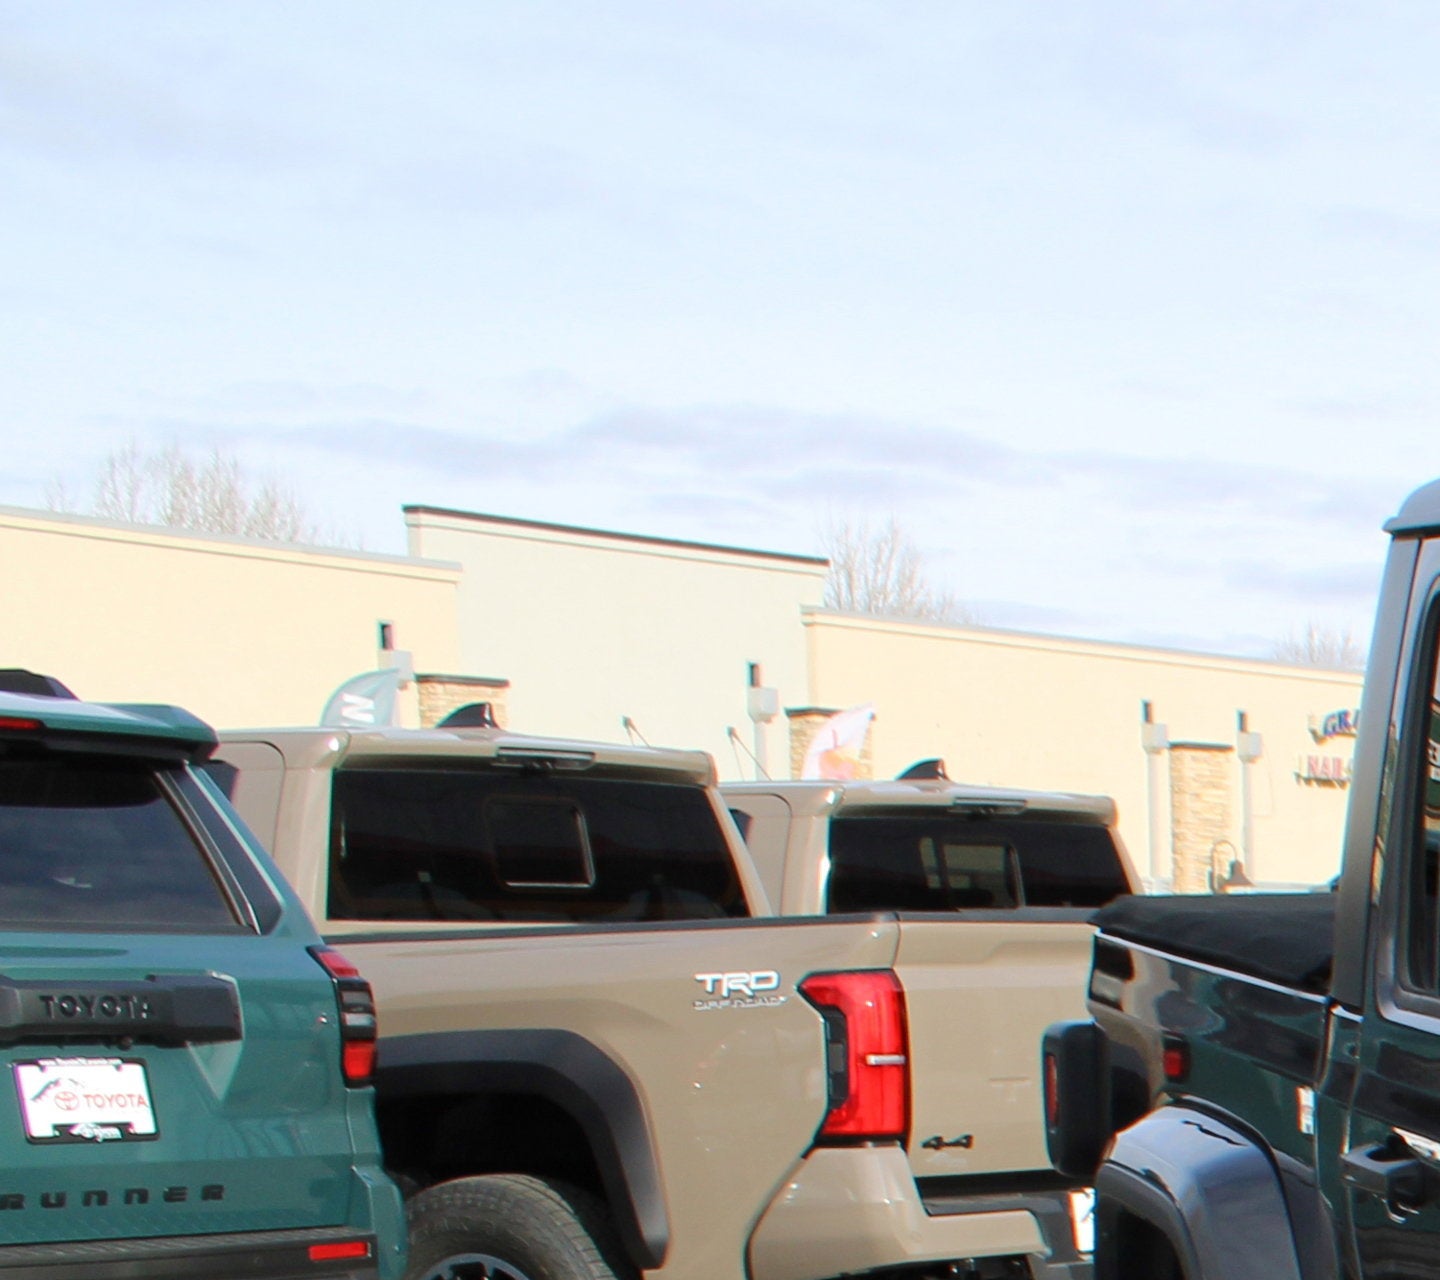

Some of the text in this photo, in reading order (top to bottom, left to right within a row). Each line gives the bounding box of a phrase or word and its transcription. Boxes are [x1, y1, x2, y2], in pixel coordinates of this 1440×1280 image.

[694, 970, 780, 998] TRD
[40, 995, 155, 1020] TOYOTA
[83, 1093, 149, 1109] TOYOTA
